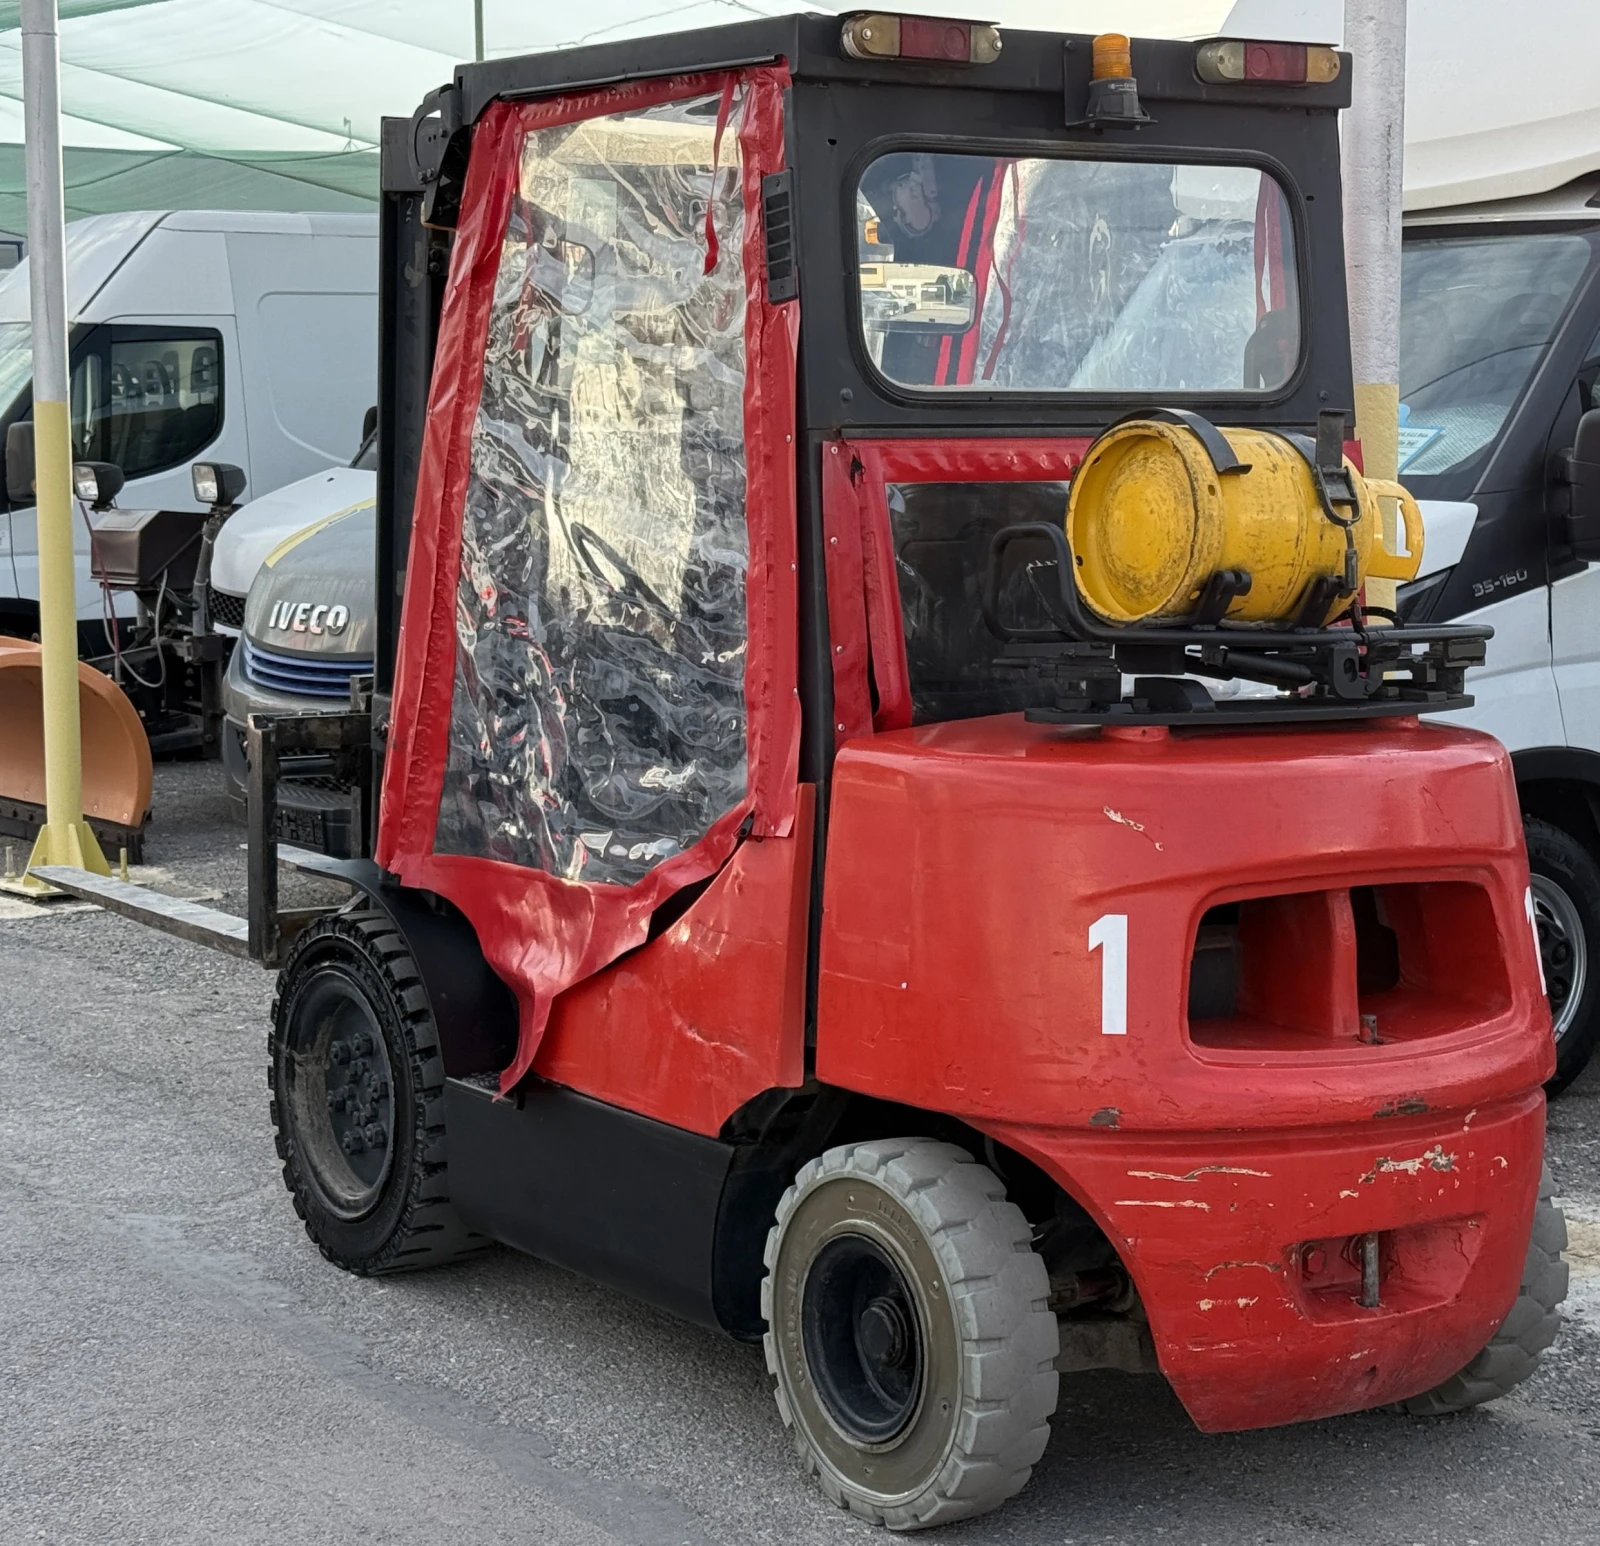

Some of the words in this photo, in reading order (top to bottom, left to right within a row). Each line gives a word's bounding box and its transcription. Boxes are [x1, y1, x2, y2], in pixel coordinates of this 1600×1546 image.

[1472, 568, 1528, 597] 35-160
[268, 600, 350, 635] IVECO
[1088, 914, 1128, 1035] 1
